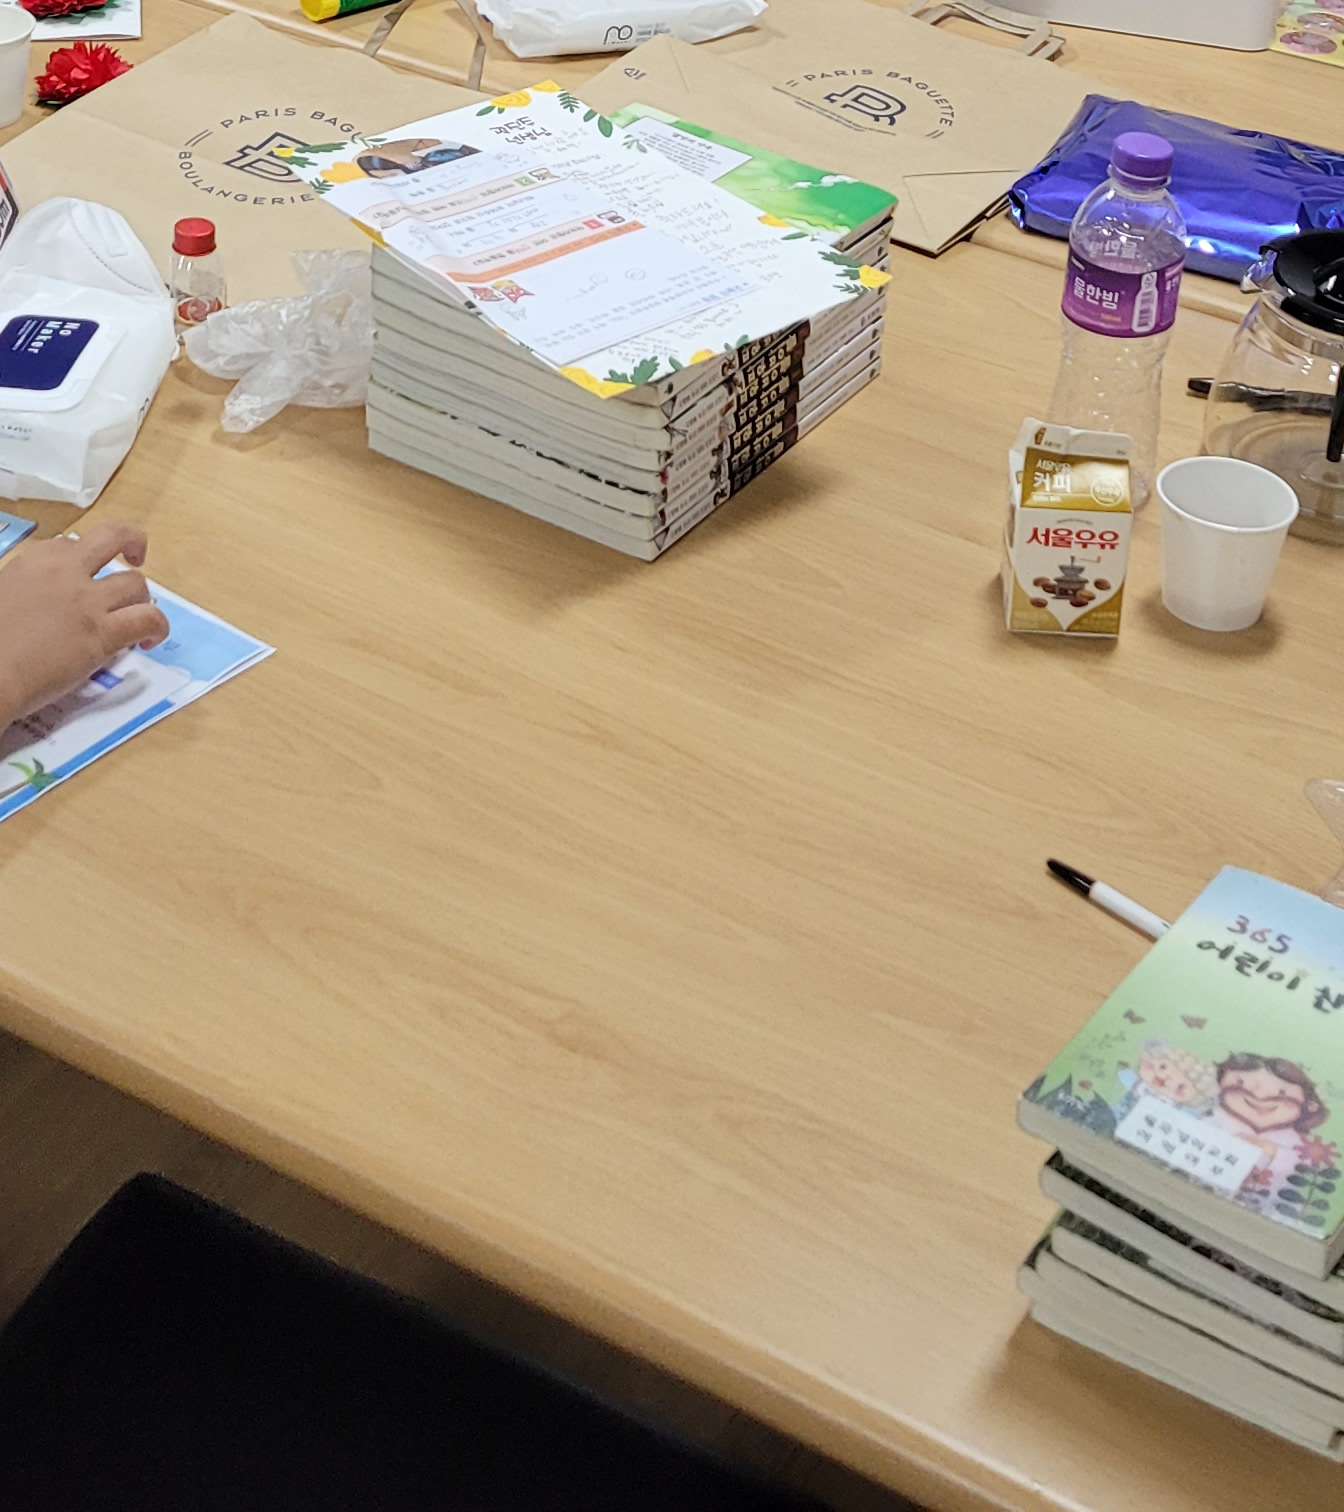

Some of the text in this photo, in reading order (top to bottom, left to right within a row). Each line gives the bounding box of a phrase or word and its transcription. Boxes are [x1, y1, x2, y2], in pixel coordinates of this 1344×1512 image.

[803, 68, 955, 127] PARIS BAGUETTE
[220, 107, 297, 129] PARIS
[178, 150, 315, 205] BOULANGERIE
[58, 321, 82, 337] No
[1033, 471, 1072, 494] 커피
[1025, 526, 1120, 551] 서울우유
[1226, 913, 1293, 956] 365
[1196, 935, 1304, 993] 어린이
